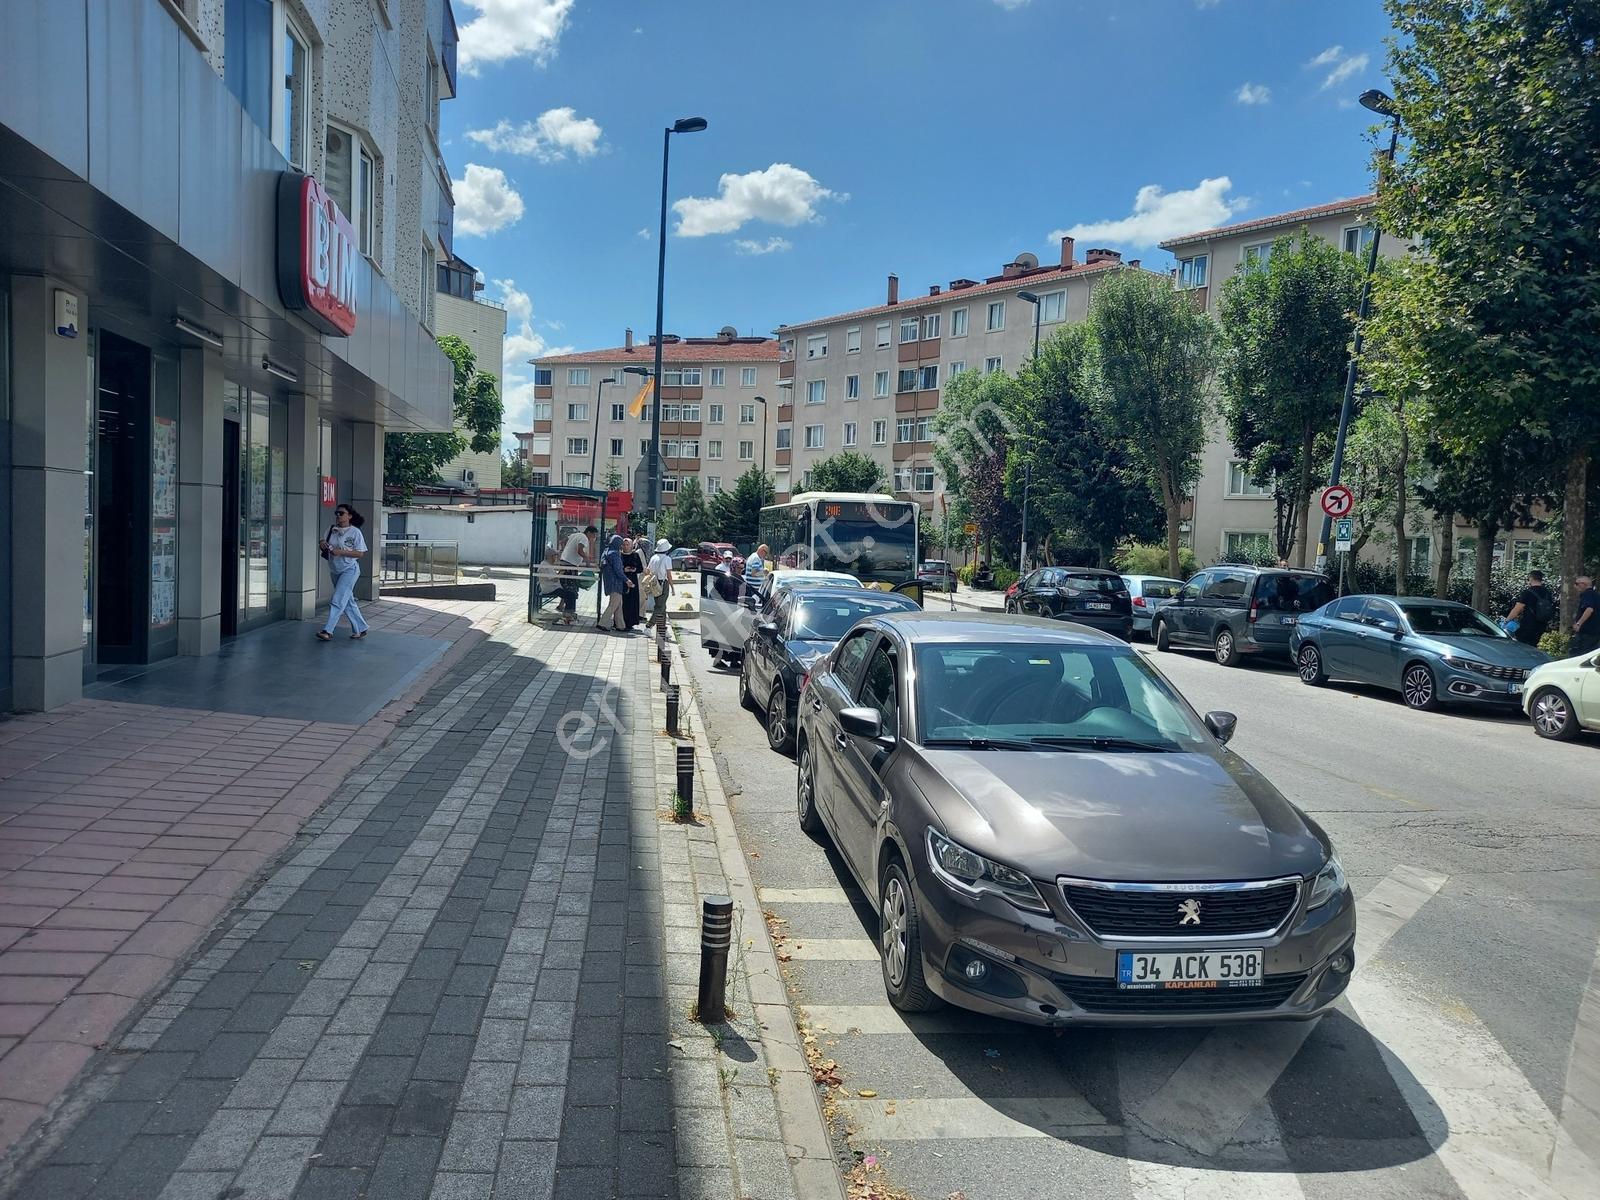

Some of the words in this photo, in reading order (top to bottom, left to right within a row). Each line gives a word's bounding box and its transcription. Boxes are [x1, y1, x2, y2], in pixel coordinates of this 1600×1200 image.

[1136, 957, 1161, 980] 34
[1172, 955, 1210, 979] ACK
[1220, 954, 1257, 978] 538
[1165, 981, 1217, 989] KAPLANLAR
